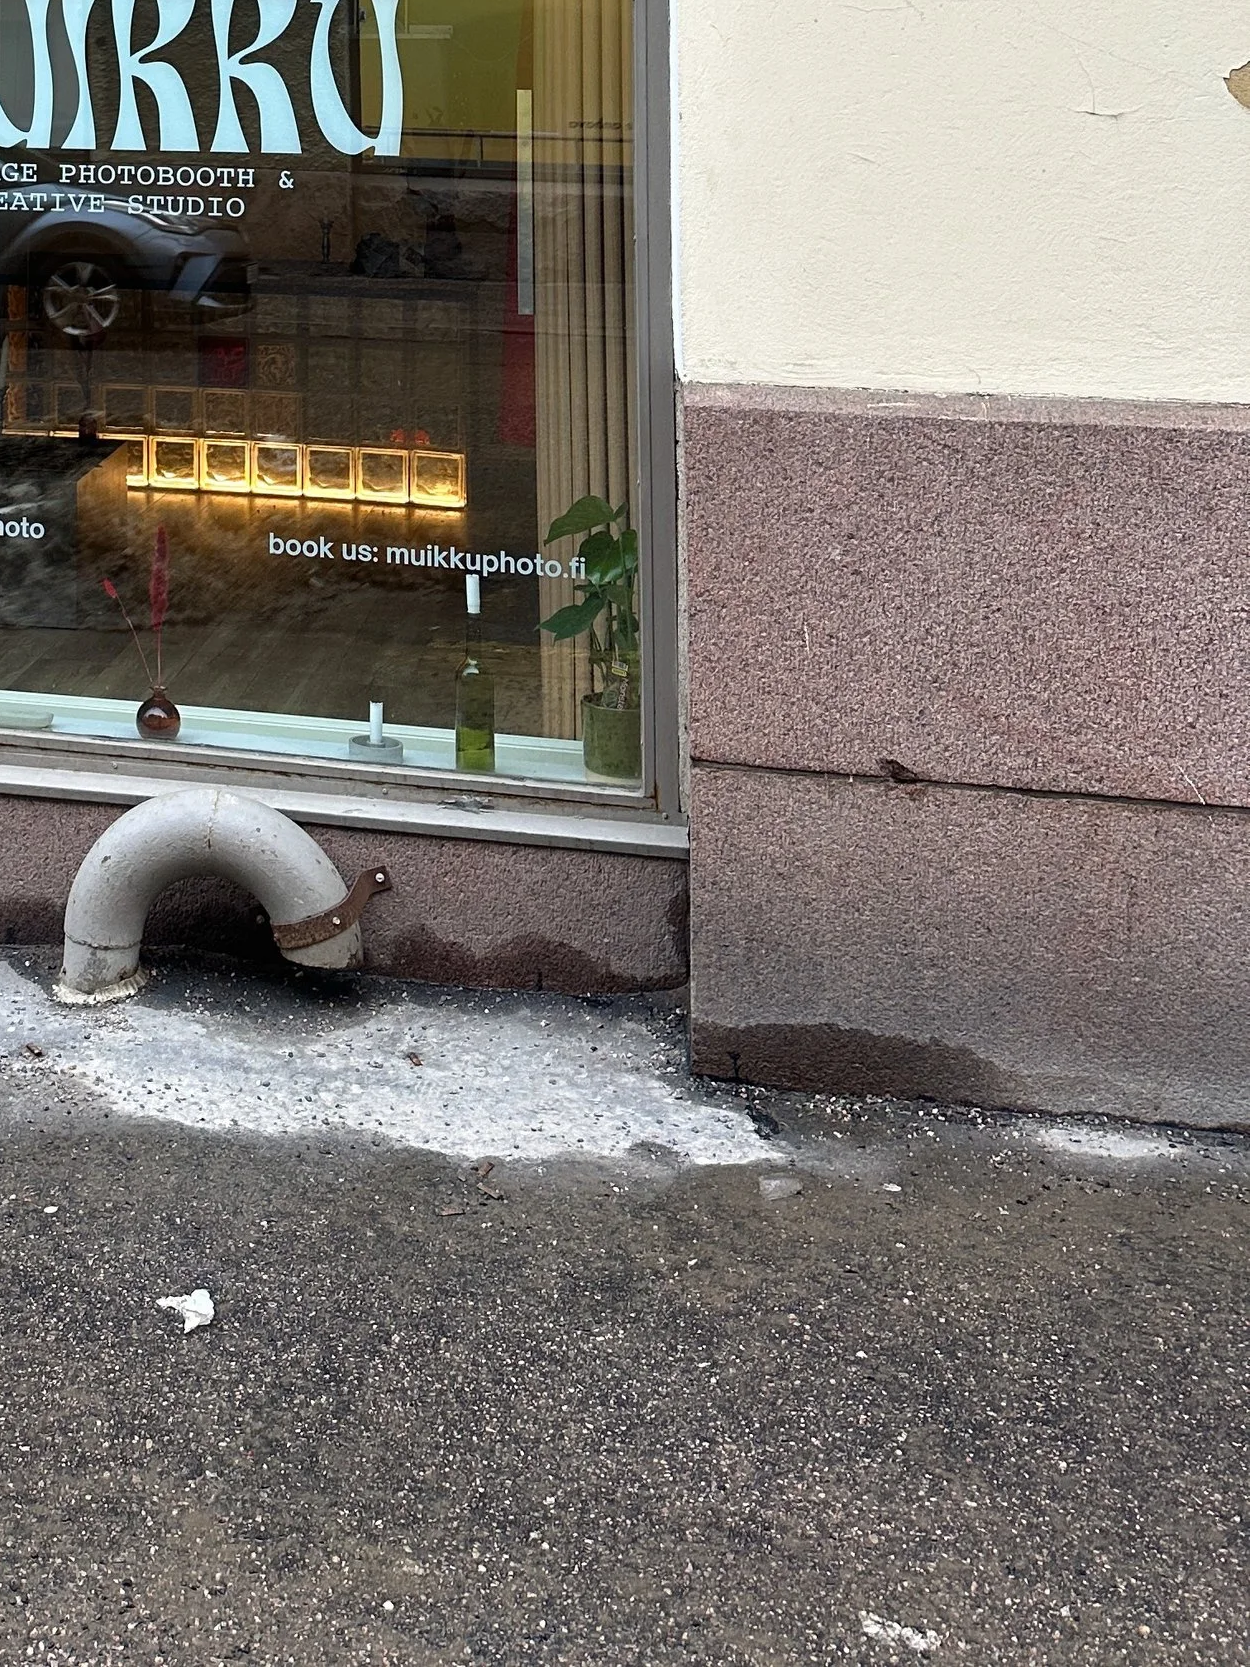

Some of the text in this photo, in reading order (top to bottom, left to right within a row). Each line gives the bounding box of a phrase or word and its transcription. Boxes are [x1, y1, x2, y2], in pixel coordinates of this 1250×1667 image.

[59, 164, 256, 188] PHOTOBOOTH
[278, 170, 295, 190] &
[127, 194, 246, 218] STUDIO
[269, 533, 586, 580] book us: muikkuphoto.fi
